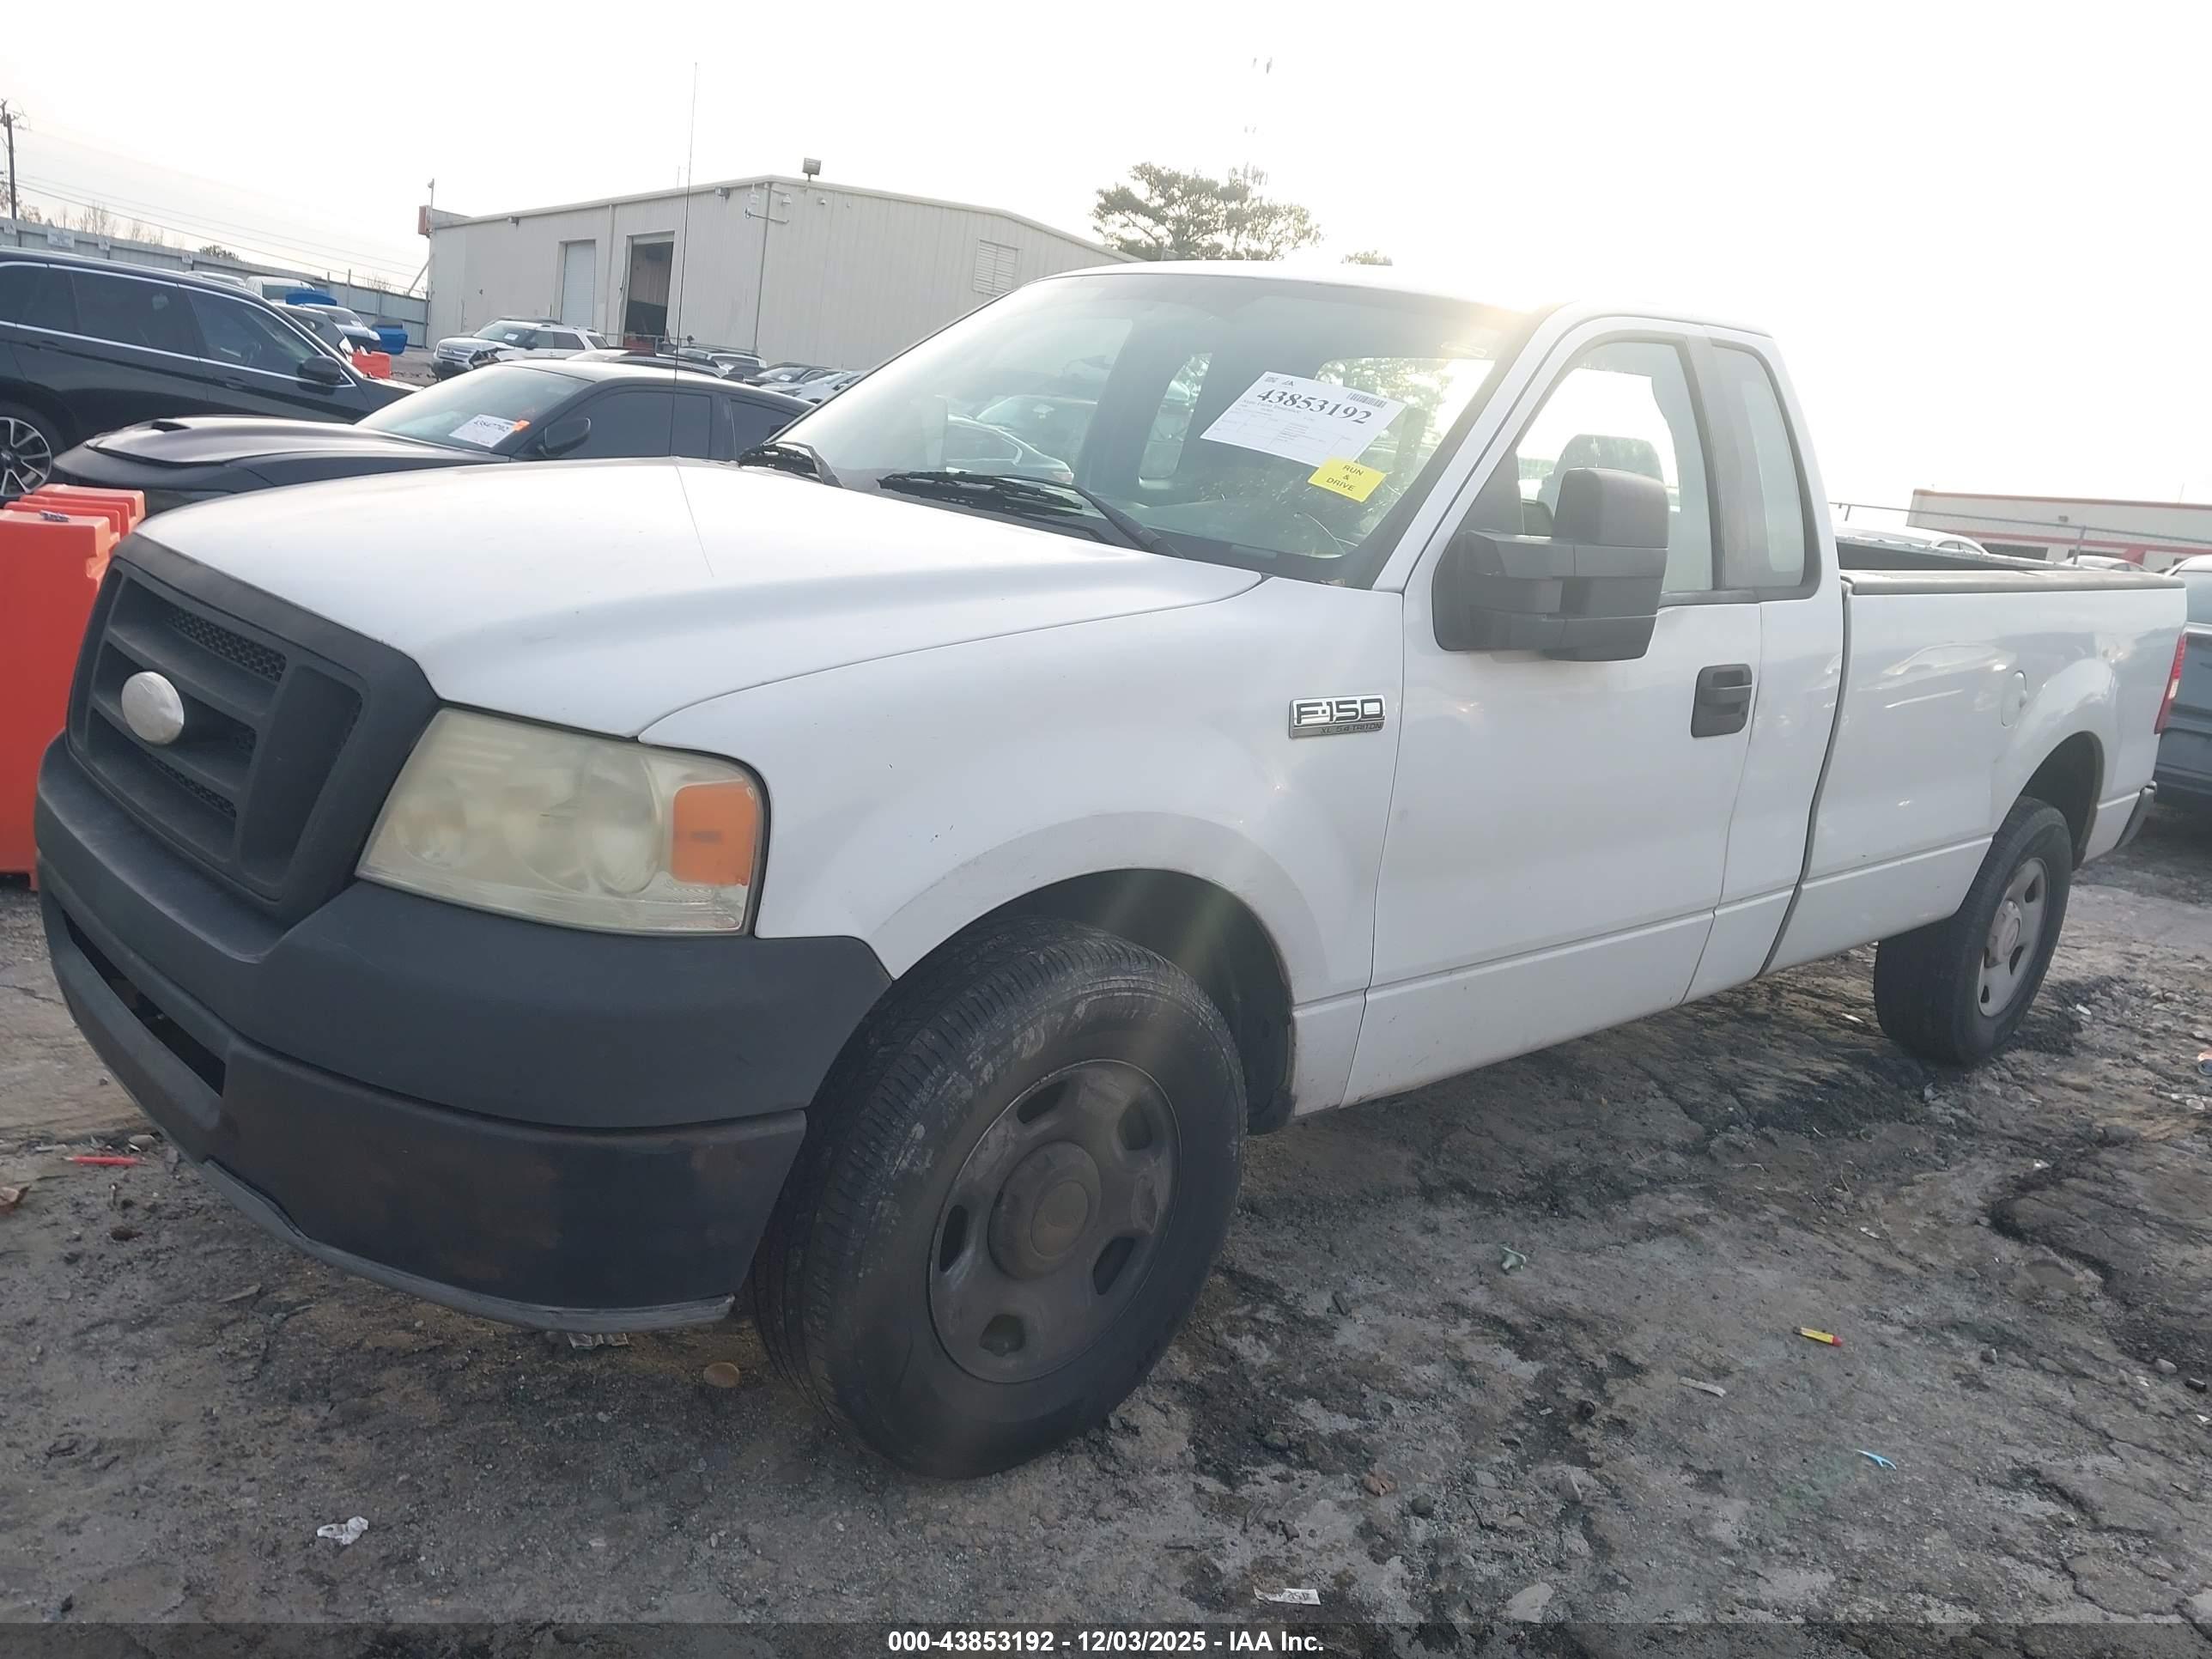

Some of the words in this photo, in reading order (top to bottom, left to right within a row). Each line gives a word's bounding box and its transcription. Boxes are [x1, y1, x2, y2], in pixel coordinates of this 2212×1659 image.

[1256, 388, 1373, 424] 43853192
[1342, 465, 1364, 477] RUN
[1326, 477, 1357, 492] DRIVE
[1352, 722, 1382, 732] TRITON
